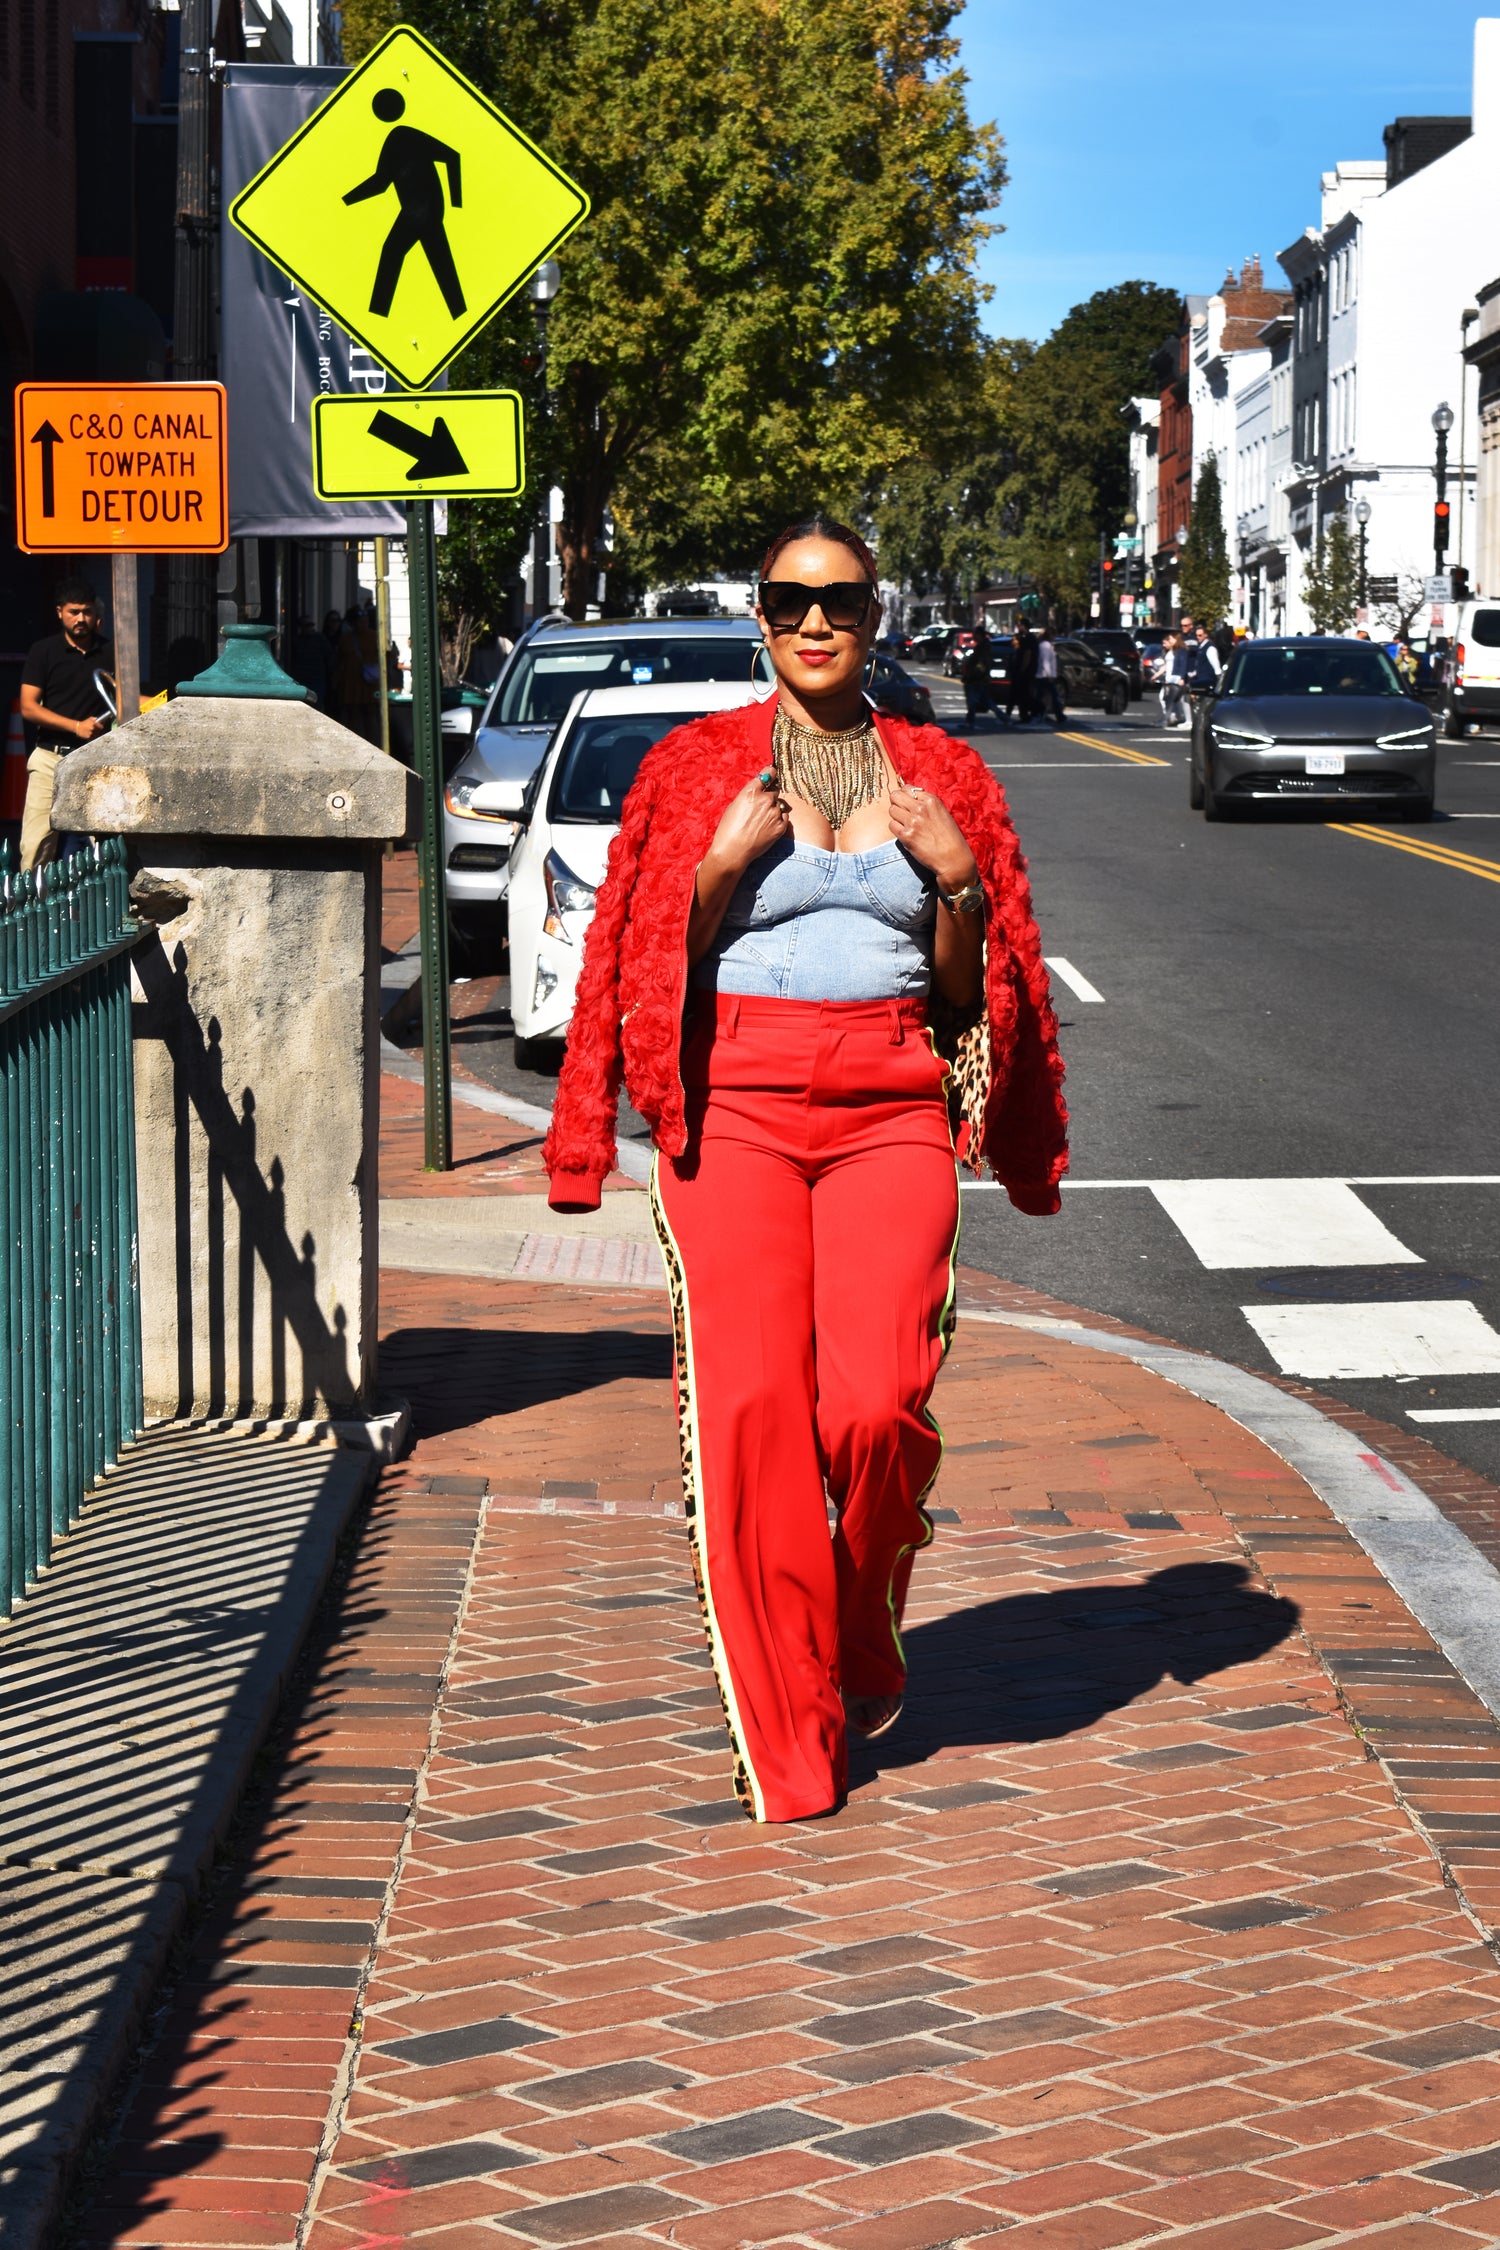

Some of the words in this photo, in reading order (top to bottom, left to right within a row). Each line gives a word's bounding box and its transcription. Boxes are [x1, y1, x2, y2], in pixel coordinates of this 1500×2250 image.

[349, 335, 387, 395] IP
[69, 413, 123, 440] C&O
[134, 413, 213, 440] CANAL
[86, 451, 195, 477] TOWPATH
[82, 489, 203, 523] DETOUR
